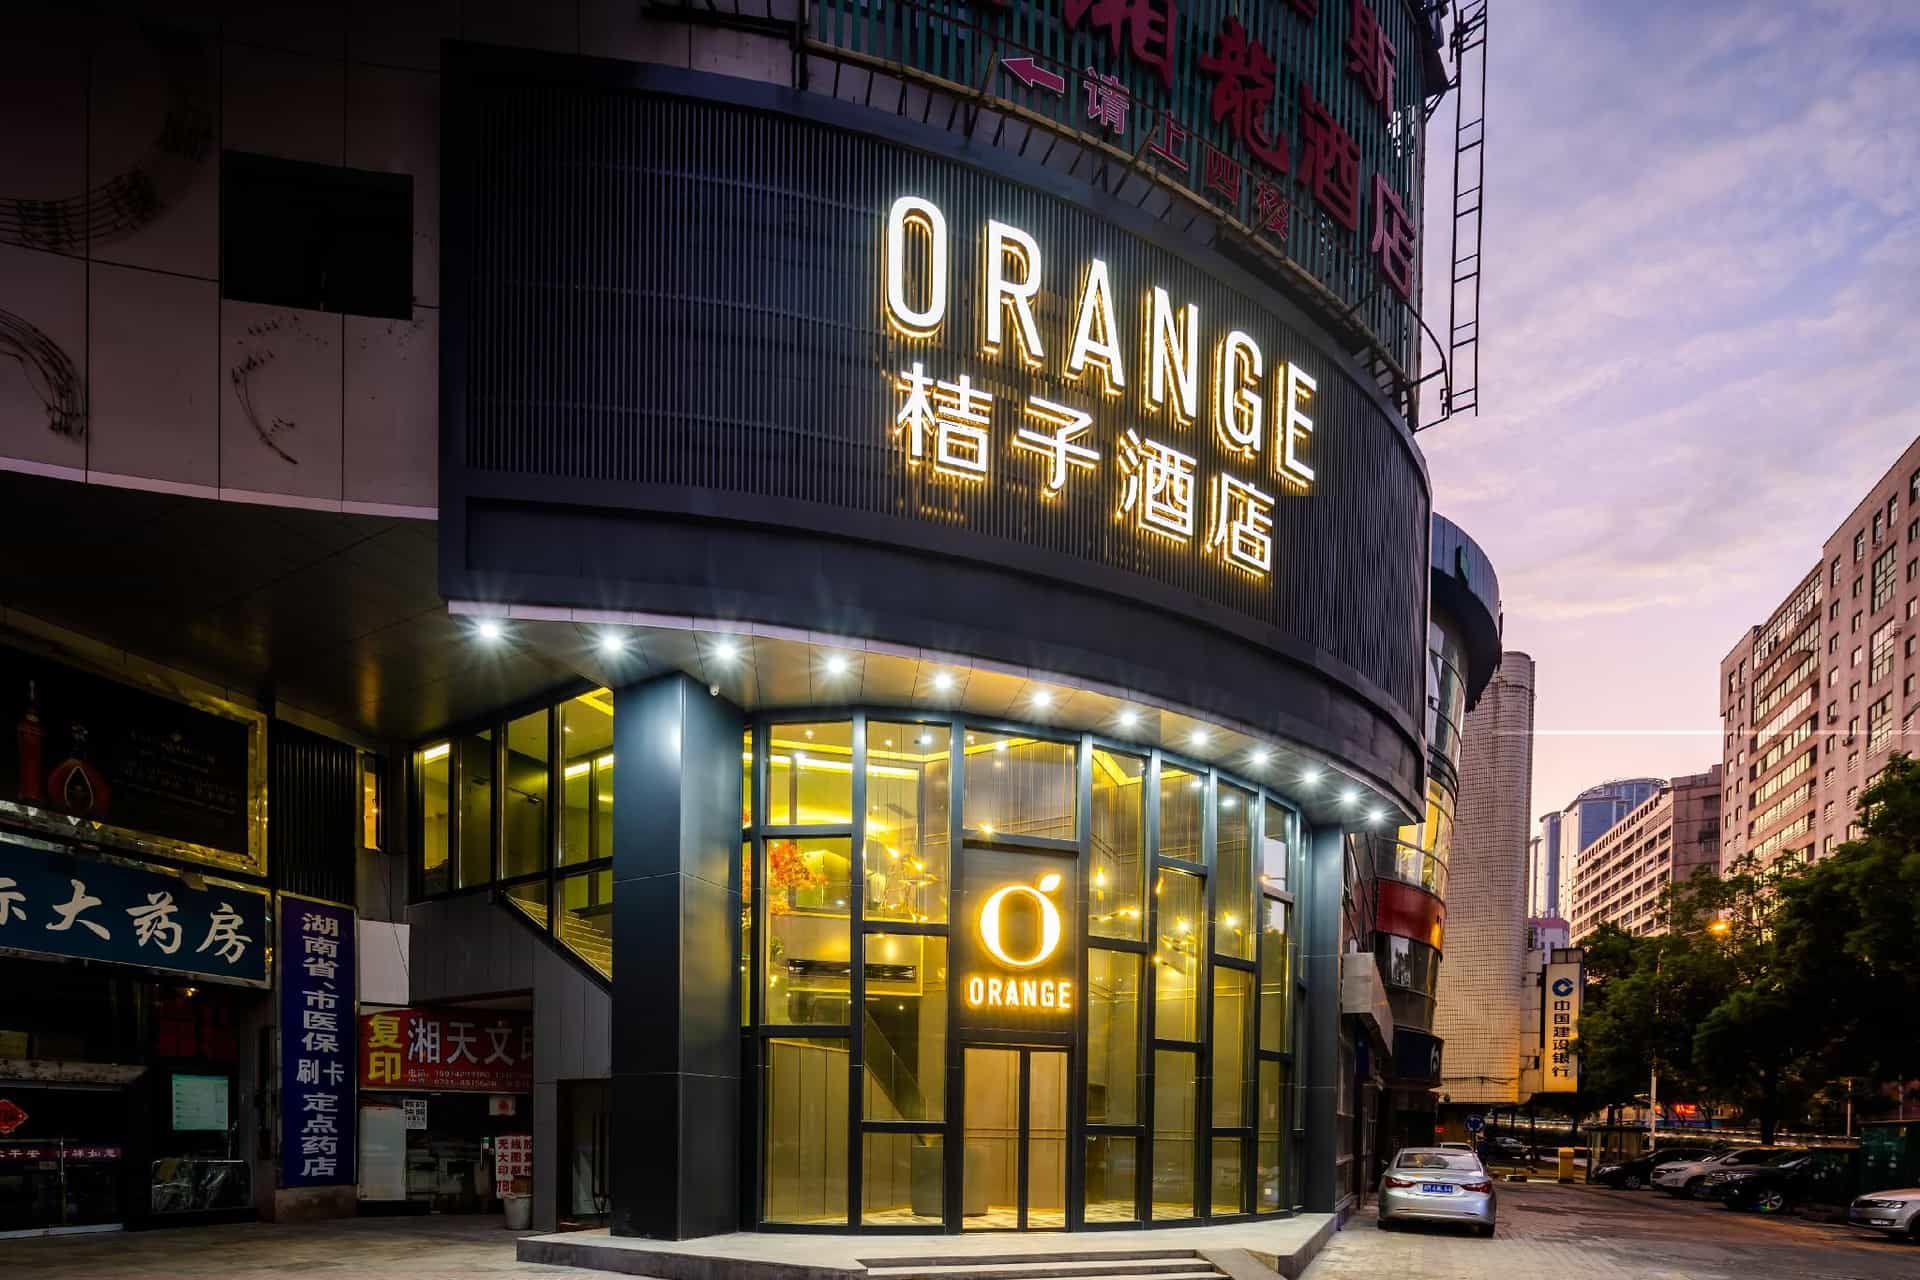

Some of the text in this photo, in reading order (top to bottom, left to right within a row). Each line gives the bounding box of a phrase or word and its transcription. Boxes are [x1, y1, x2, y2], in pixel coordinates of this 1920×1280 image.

[1083, 65, 1290, 242] 请上四楼
[887, 195, 1318, 483] ORANGE
[894, 361, 1276, 574] 桔子酒店
[367, 1013, 403, 1085] 复印
[969, 977, 1073, 1009] ORANGE
[1551, 1000, 1571, 1078] 中国建设银行
